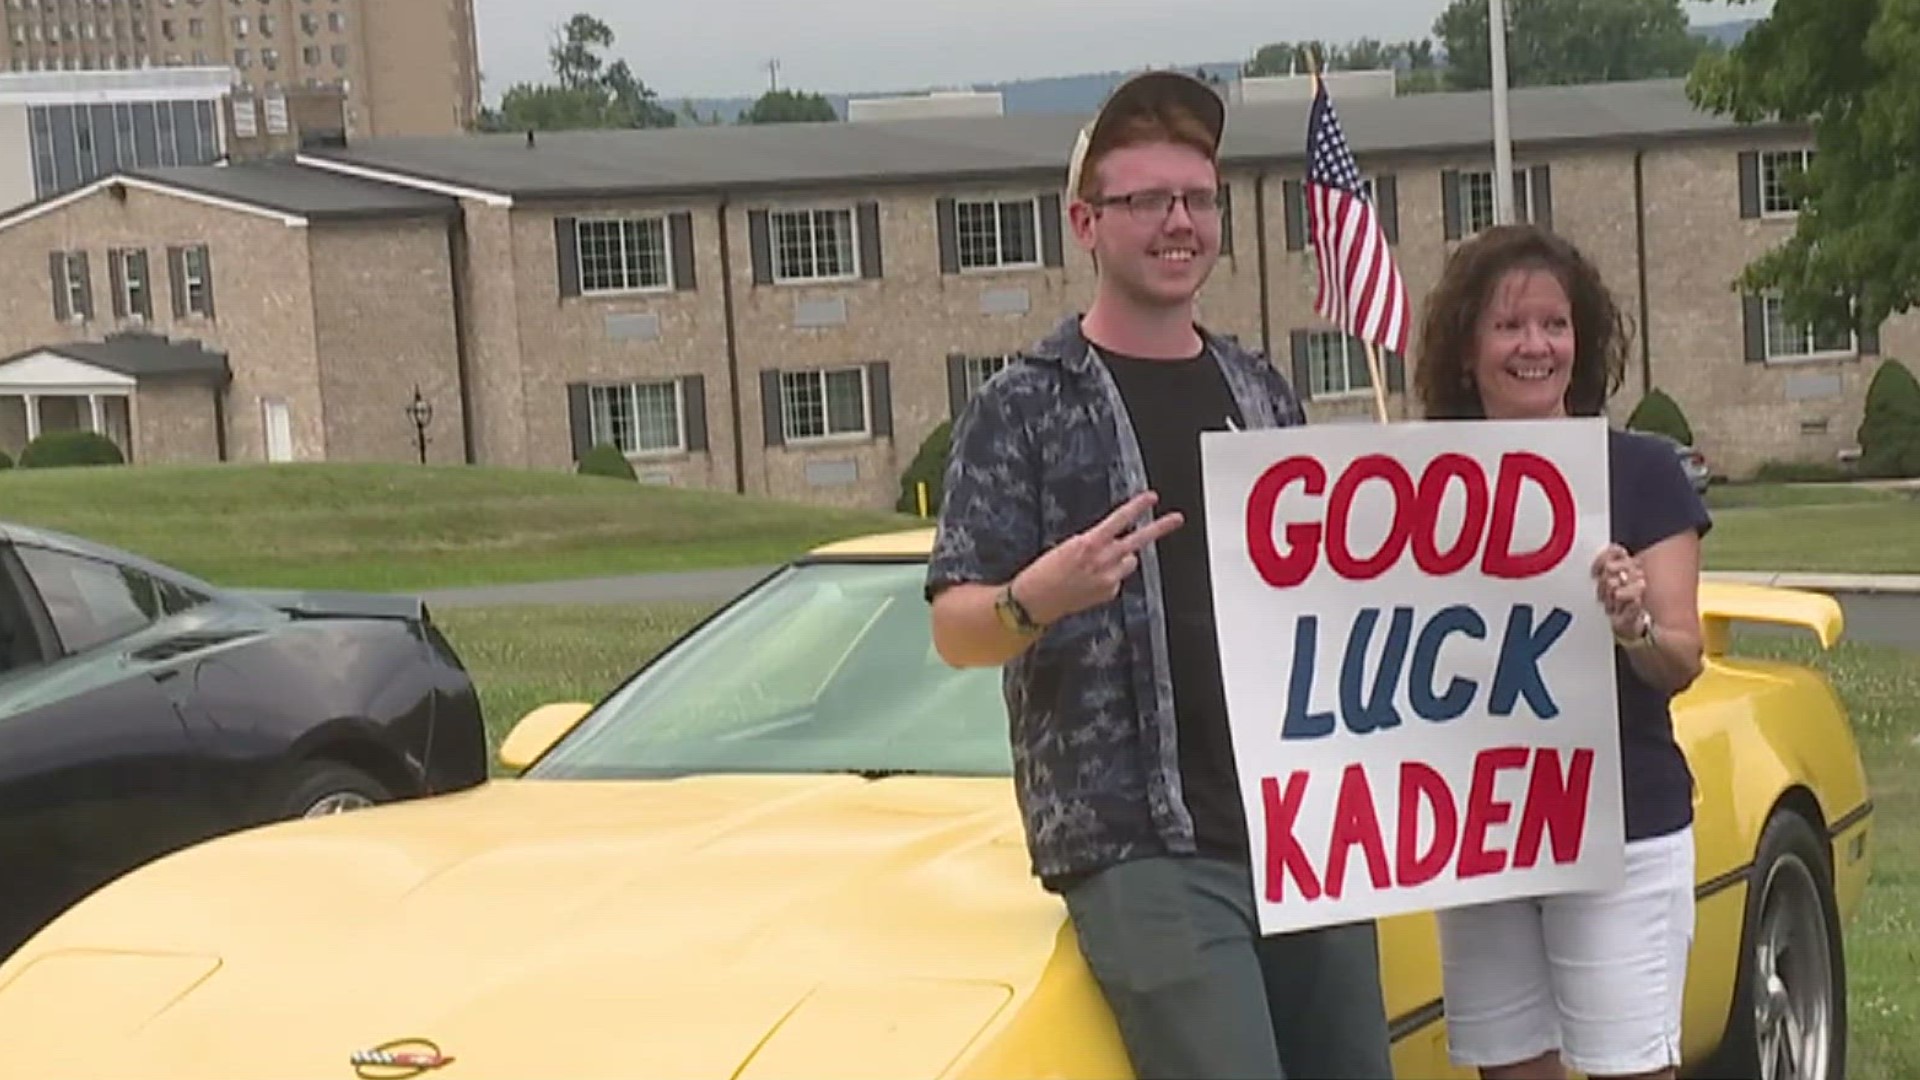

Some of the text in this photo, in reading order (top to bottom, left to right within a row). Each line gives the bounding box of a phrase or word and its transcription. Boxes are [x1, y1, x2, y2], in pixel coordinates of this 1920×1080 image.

[1246, 452, 1576, 588] GOOD
[1281, 604, 1573, 740] LUCK
[1261, 747, 1595, 903] KADEN
